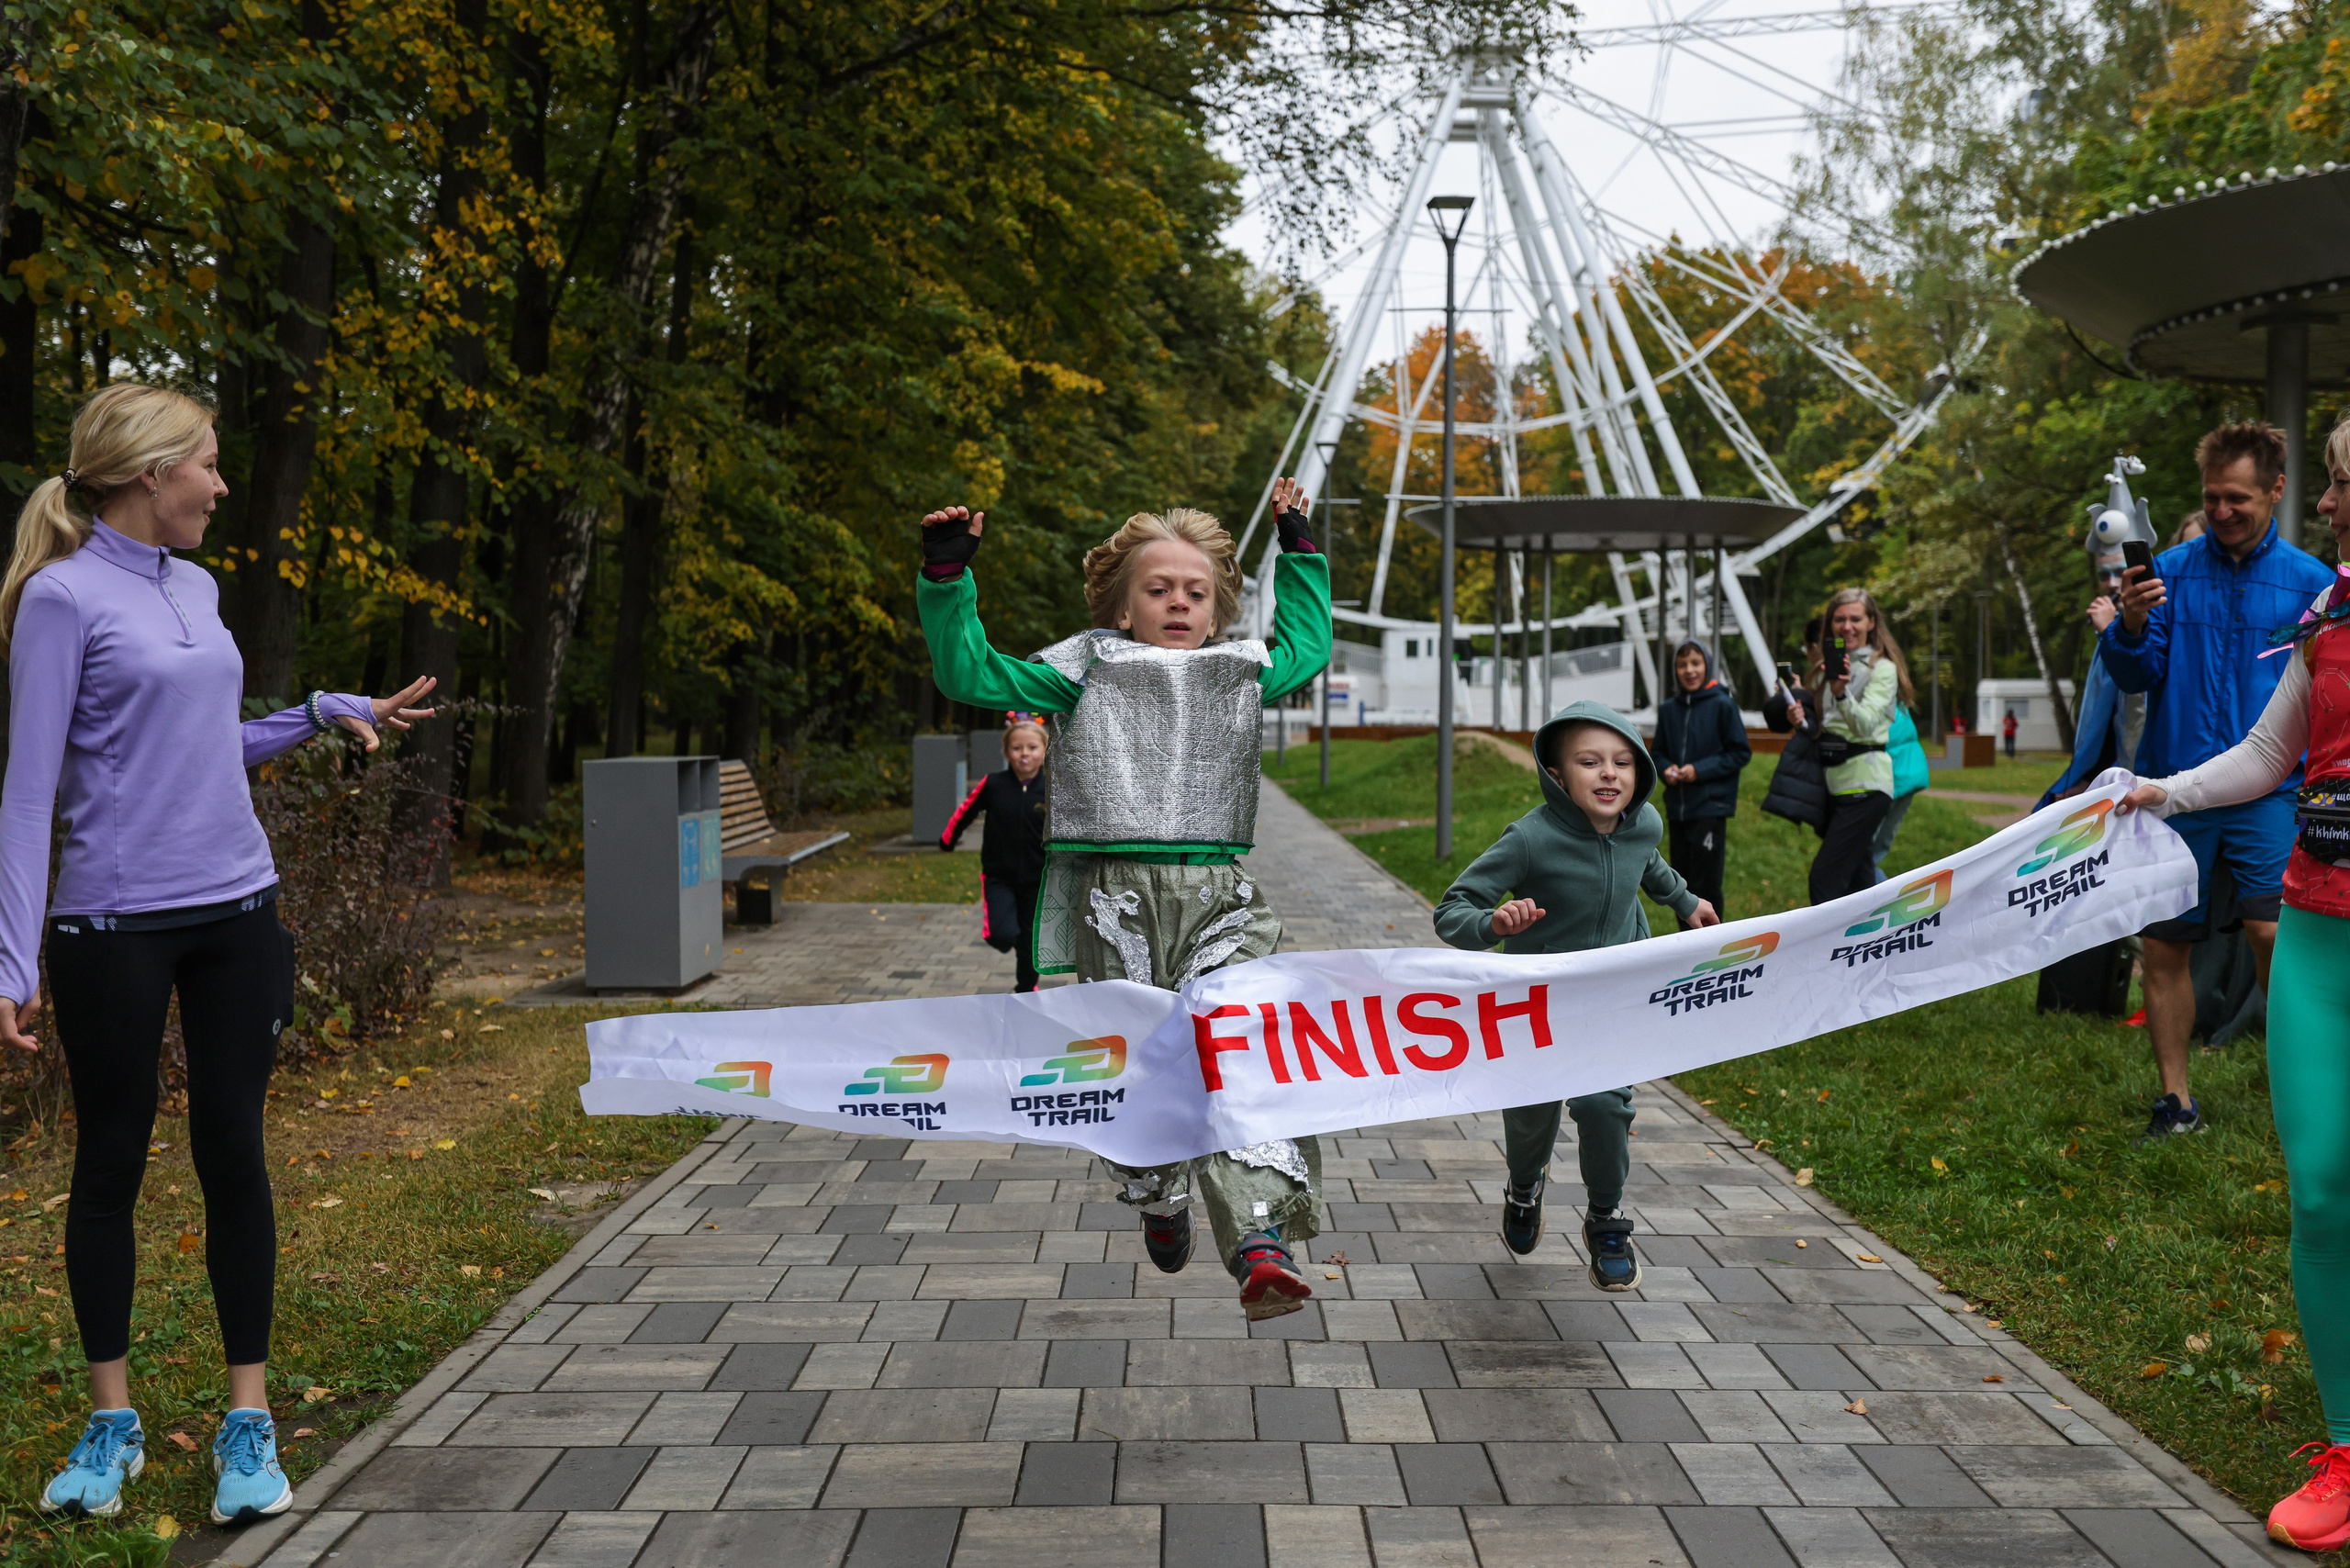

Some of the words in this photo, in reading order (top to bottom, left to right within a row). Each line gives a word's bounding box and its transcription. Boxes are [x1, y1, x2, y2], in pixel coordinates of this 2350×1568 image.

[1704, 832, 1713, 850] 4
[2307, 825, 2350, 840] #khimk
[2008, 849, 2109, 907] DREAM
[2023, 874, 2106, 918] TRAIL
[1842, 933, 1934, 968] TRAIL
[1649, 963, 1764, 1004] DREAM
[1663, 983, 1754, 1016] TRAIL
[1192, 984, 1553, 1092] FINISH
[837, 1102, 946, 1117] DREAM
[1011, 1088, 1125, 1112] DREAM
[1027, 1106, 1115, 1127] TRAIL
